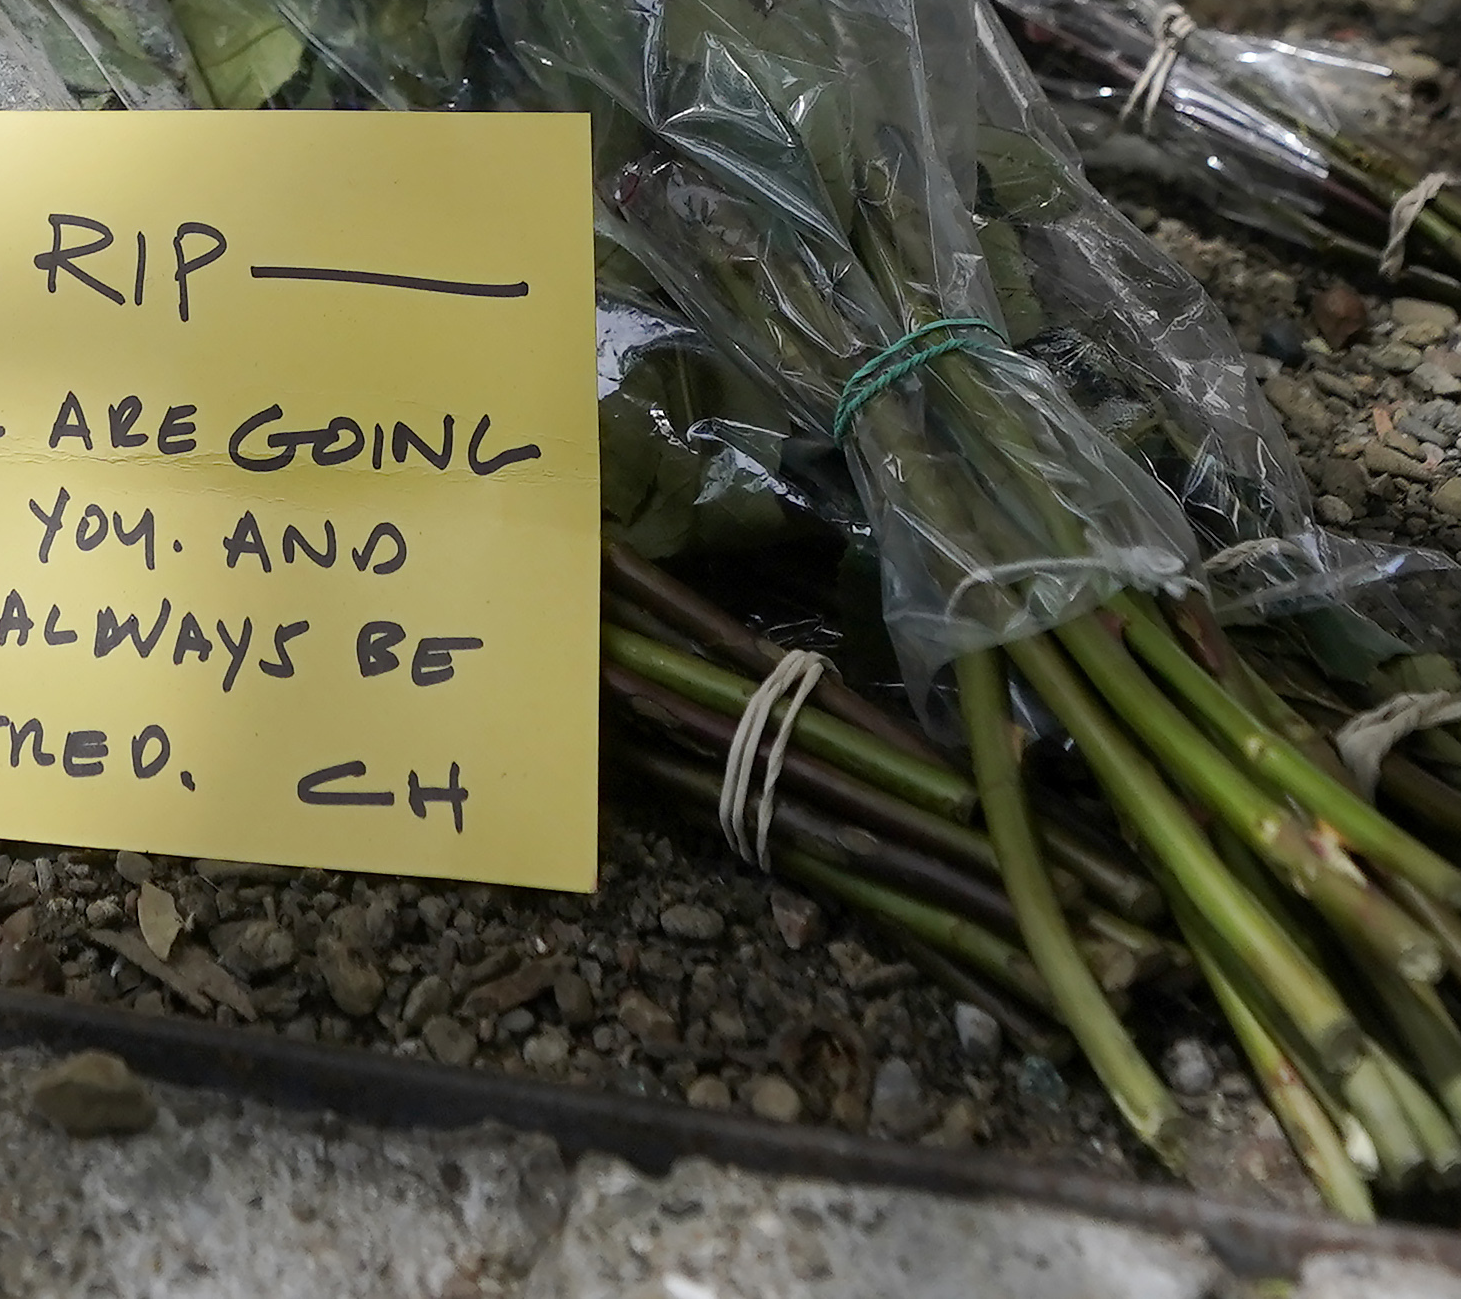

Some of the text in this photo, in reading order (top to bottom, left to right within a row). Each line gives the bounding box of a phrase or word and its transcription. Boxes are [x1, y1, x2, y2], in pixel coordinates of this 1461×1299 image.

[47, 389, 199, 457] ARE
[227, 402, 543, 478] GOING
[28, 485, 184, 572] YOU.
[221, 508, 409, 576] AND
[355, 619, 485, 688] BE
[295, 759, 470, 836] CH
